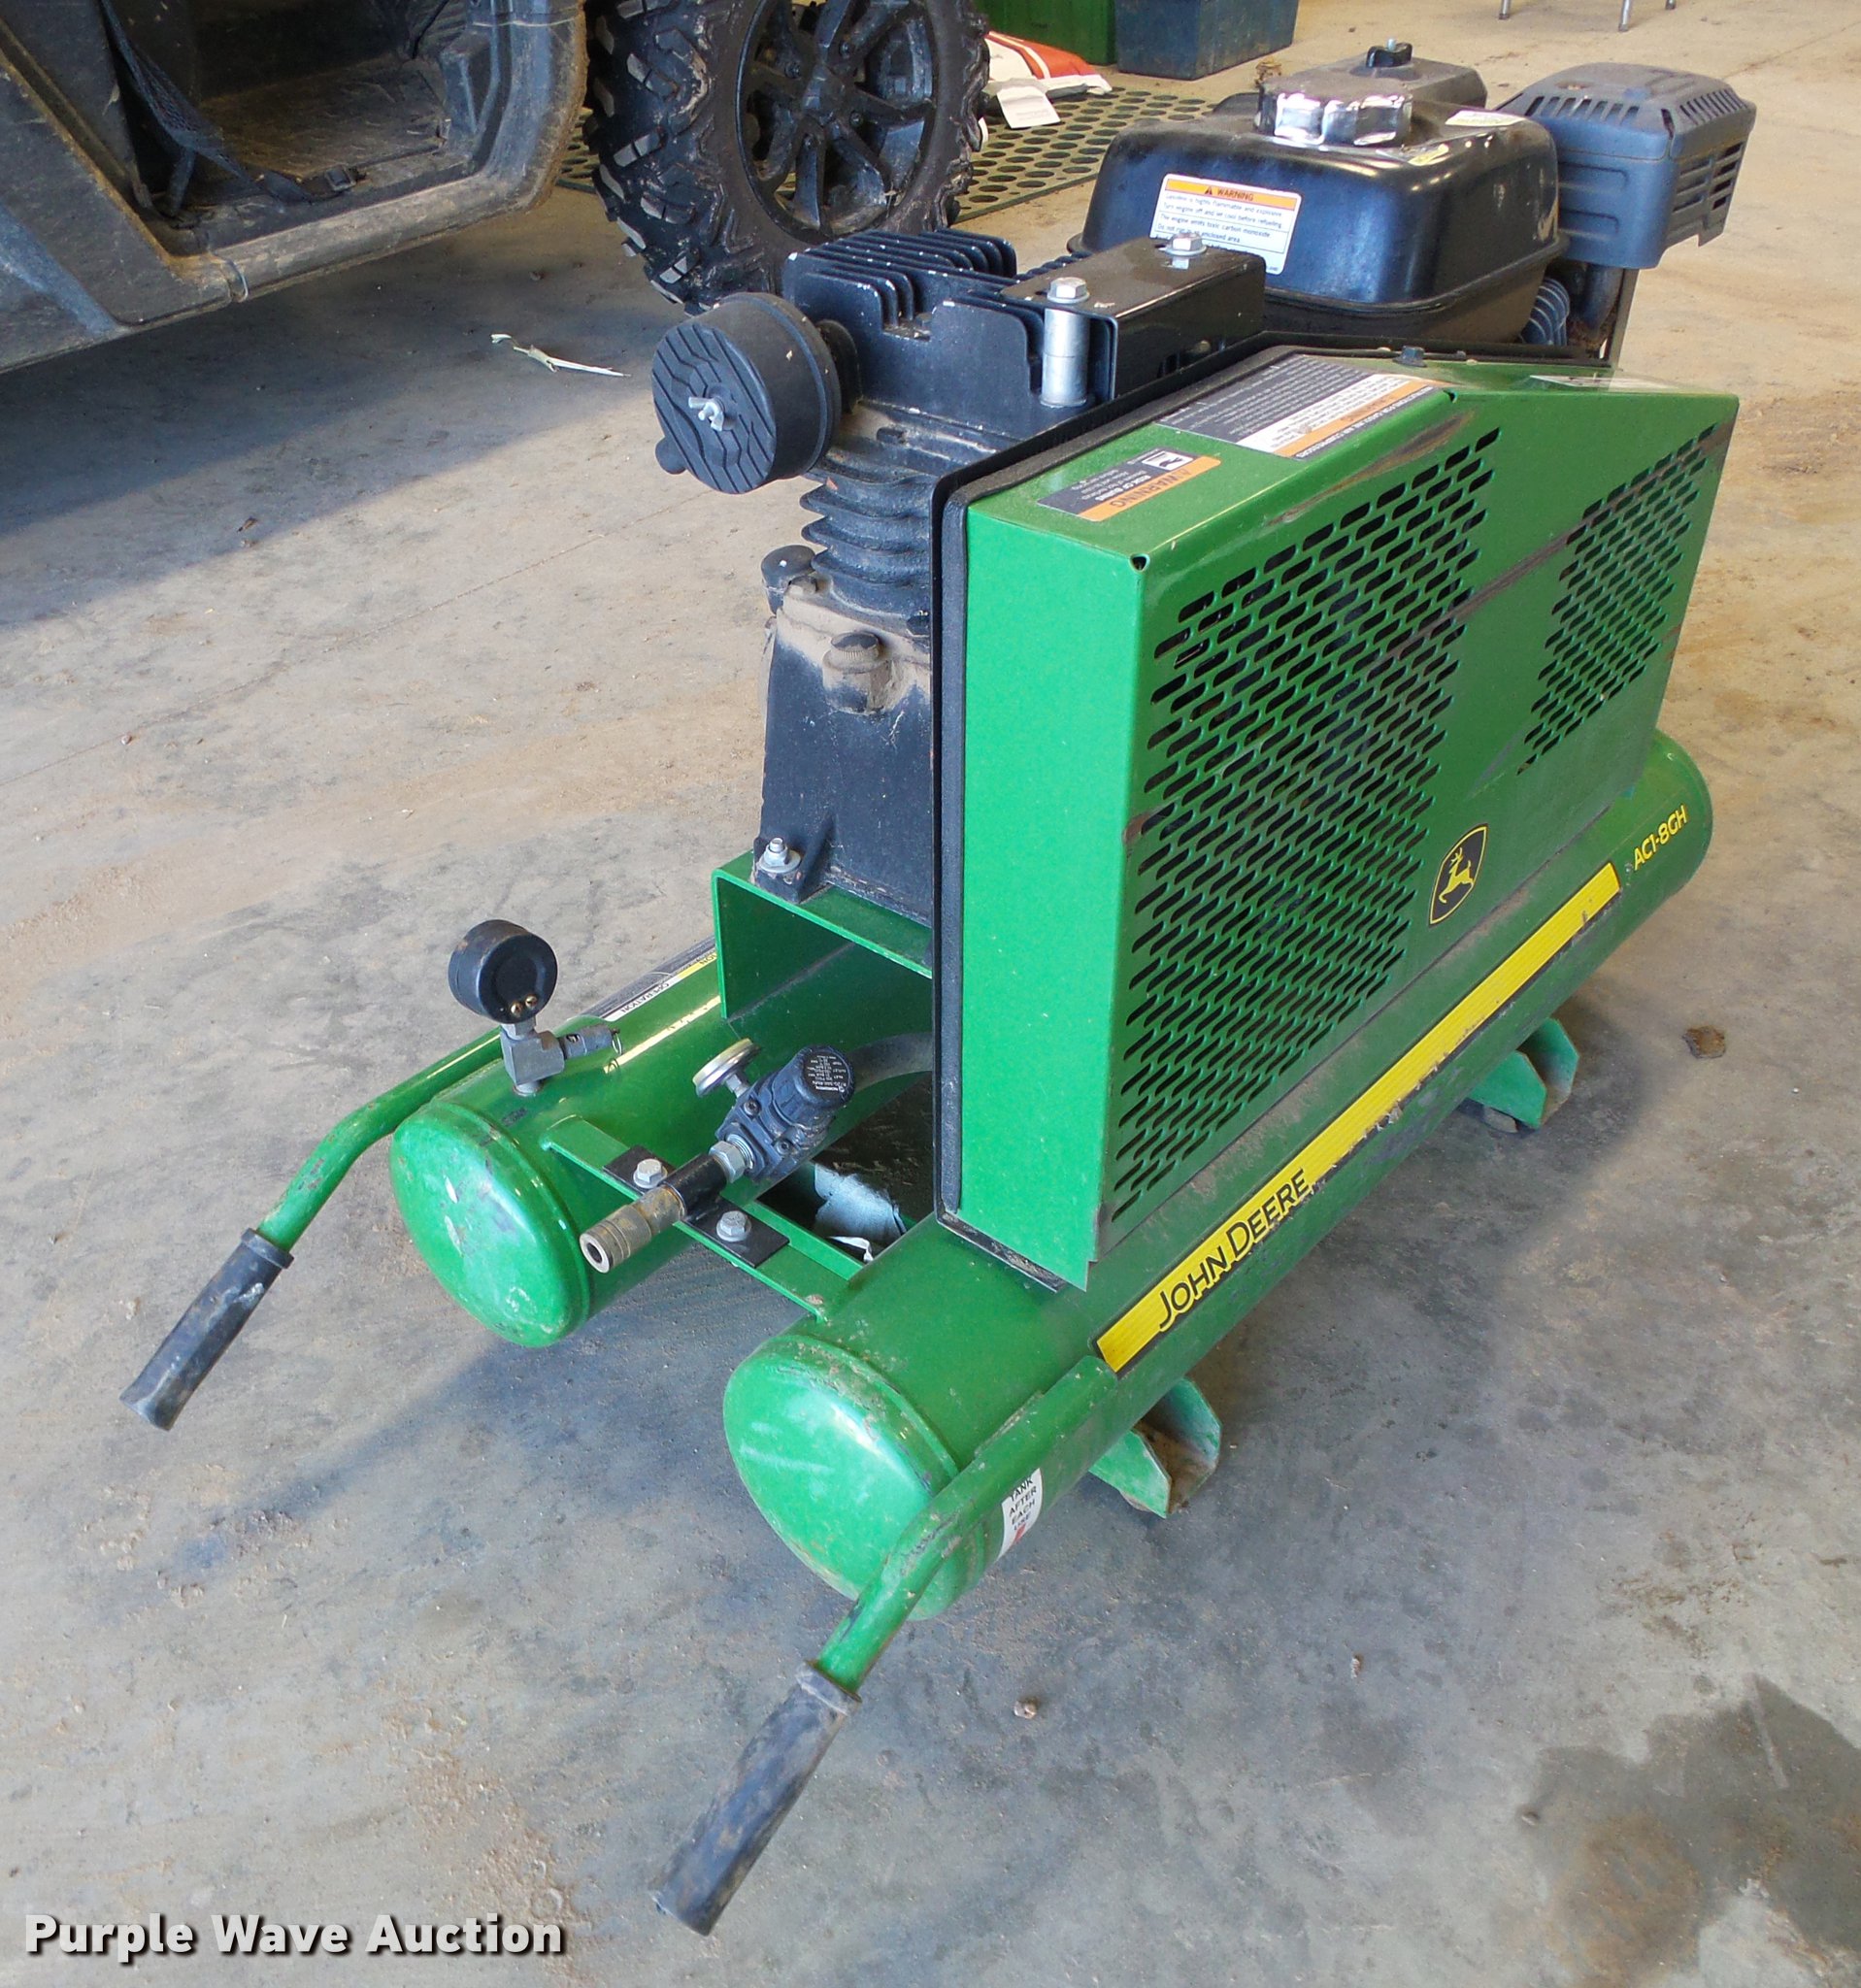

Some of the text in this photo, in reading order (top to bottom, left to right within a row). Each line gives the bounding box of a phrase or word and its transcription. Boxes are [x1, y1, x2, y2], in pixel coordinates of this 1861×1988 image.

[1216, 188, 1254, 202] WARNING
[1176, 205, 1194, 214] engine
[1238, 214, 1256, 223] before
[1221, 223, 1242, 232] carbon
[1109, 475, 1180, 509] WARNING
[1634, 804, 1687, 871] AC1-8GH
[1159, 1168, 1310, 1330] JOHN DEERE
[1010, 1485, 1037, 1517] AFTER
[1012, 1498, 1036, 1525] EACH
